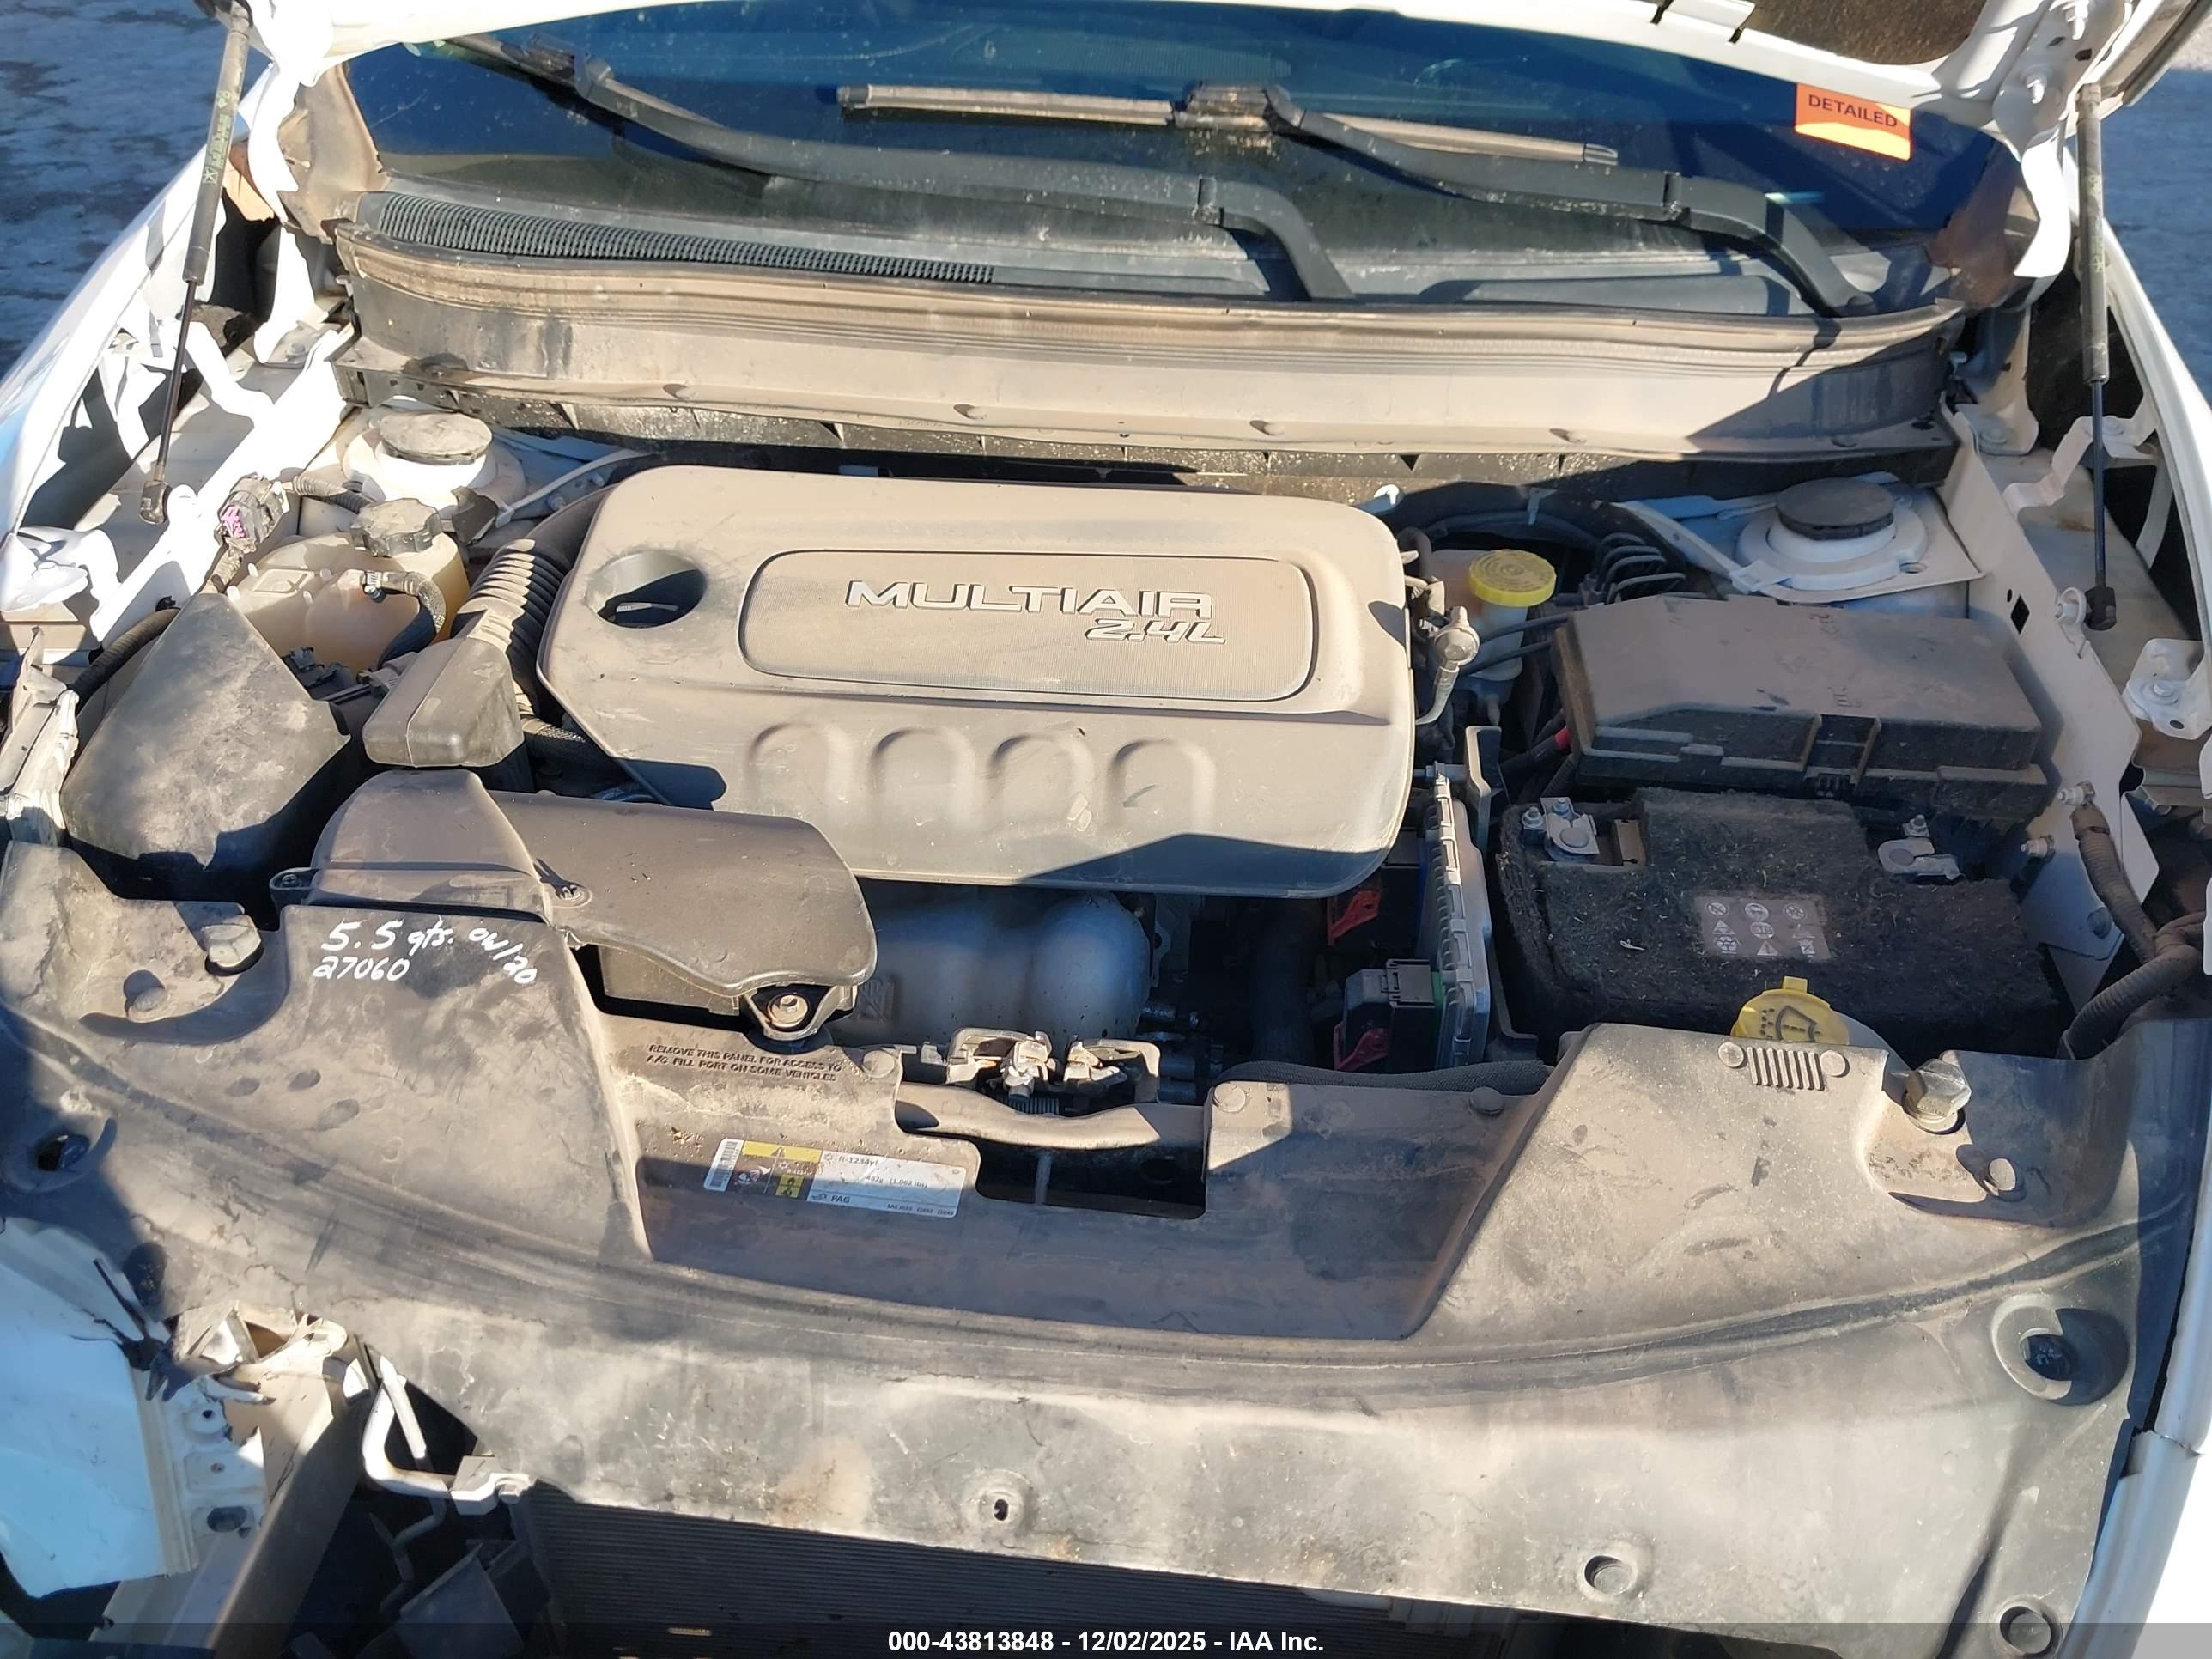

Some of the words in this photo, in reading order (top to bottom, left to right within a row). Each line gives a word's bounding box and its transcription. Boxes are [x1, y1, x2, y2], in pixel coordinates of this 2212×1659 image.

[1808, 94, 1898, 128] DETAILED
[845, 580, 1213, 619] MULTIAIR
[1084, 618, 1227, 644] 2.4L
[312, 955, 411, 981] 27060
[646, 1054, 669, 1065] A/C
[673, 1057, 695, 1067] FILL
[699, 1060, 728, 1071] PORT
[730, 1063, 748, 1073] ON
[749, 1065, 782, 1077] SOME
[785, 1069, 836, 1082] VEHICLES
[648, 1044, 695, 1057] REMOVE
[696, 1048, 721, 1060] THIS
[722, 1052, 757, 1065] PANEL
[759, 1056, 781, 1066] FOR
[782, 1058, 825, 1071] ACCESS
[827, 1062, 842, 1073] TO
[830, 1195, 851, 1204] PAG
